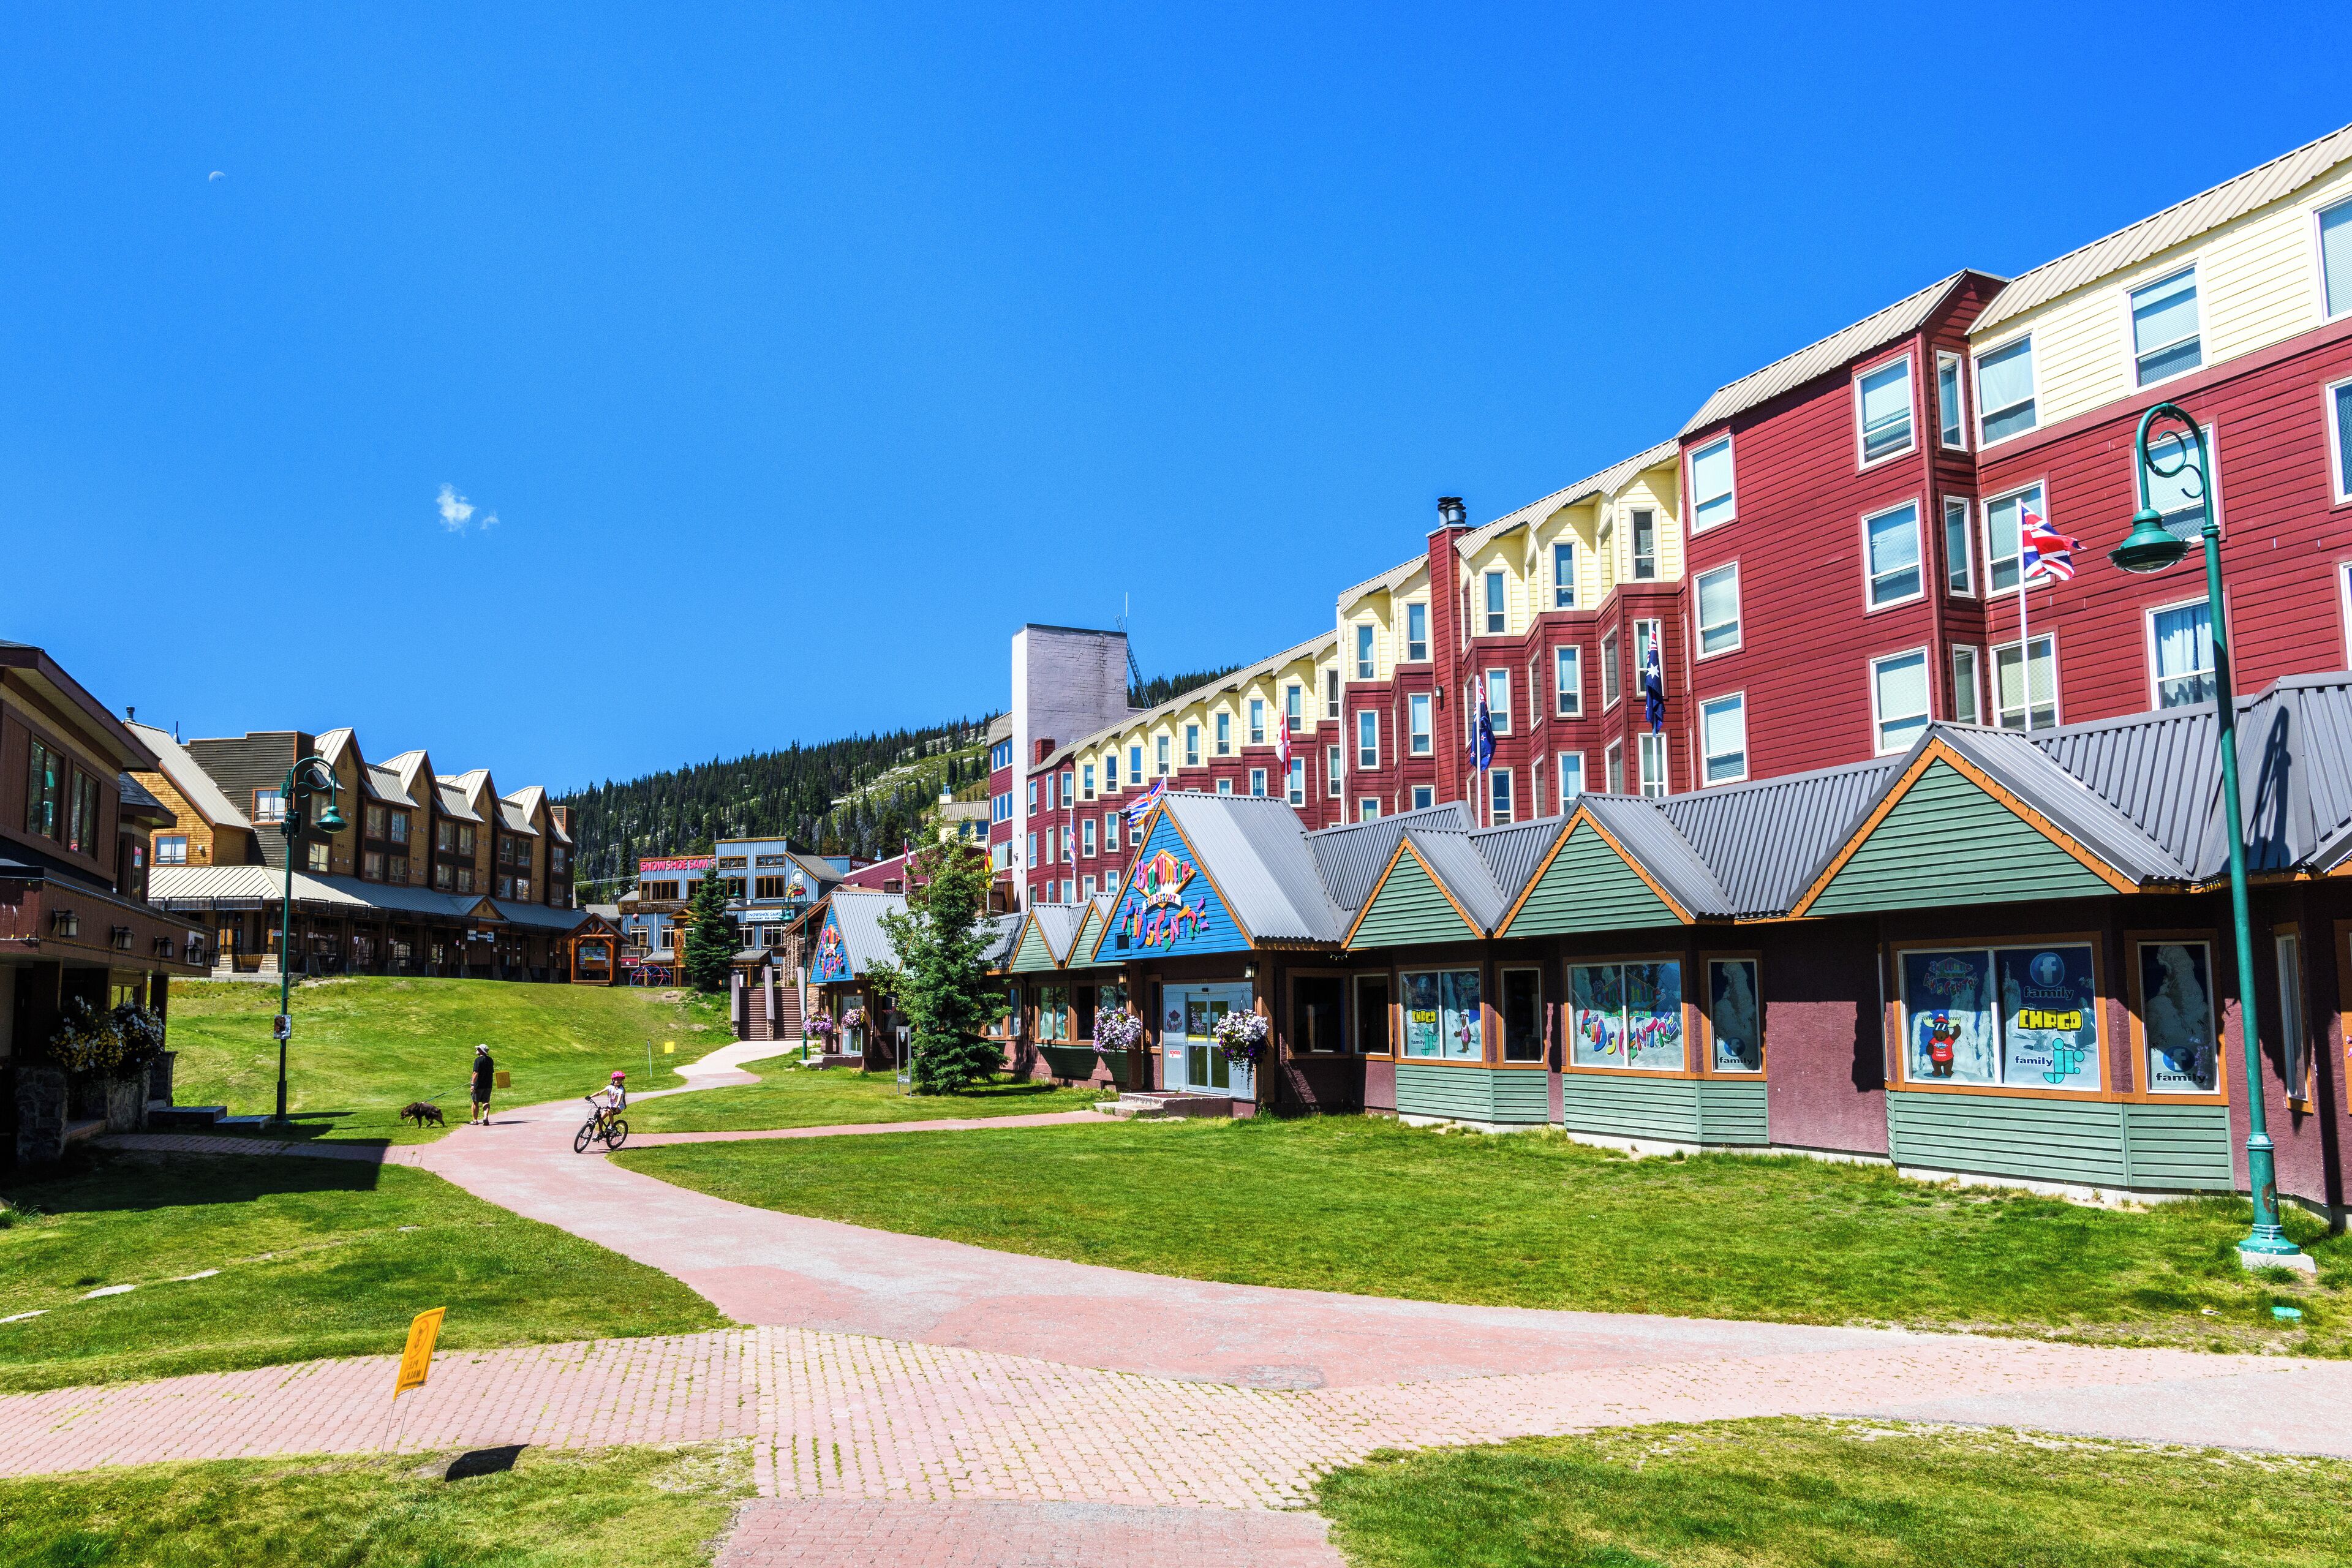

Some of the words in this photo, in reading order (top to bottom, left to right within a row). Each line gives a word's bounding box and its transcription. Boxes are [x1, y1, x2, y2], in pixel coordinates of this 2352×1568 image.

[640, 860, 687, 871] SNOWSHOE
[1145, 898, 1155, 908] SKI
[1155, 892, 1177, 903] RESORT
[2024, 986, 2075, 1001] family
[2015, 1056, 2053, 1066] family
[2155, 1072, 2206, 1084] family
